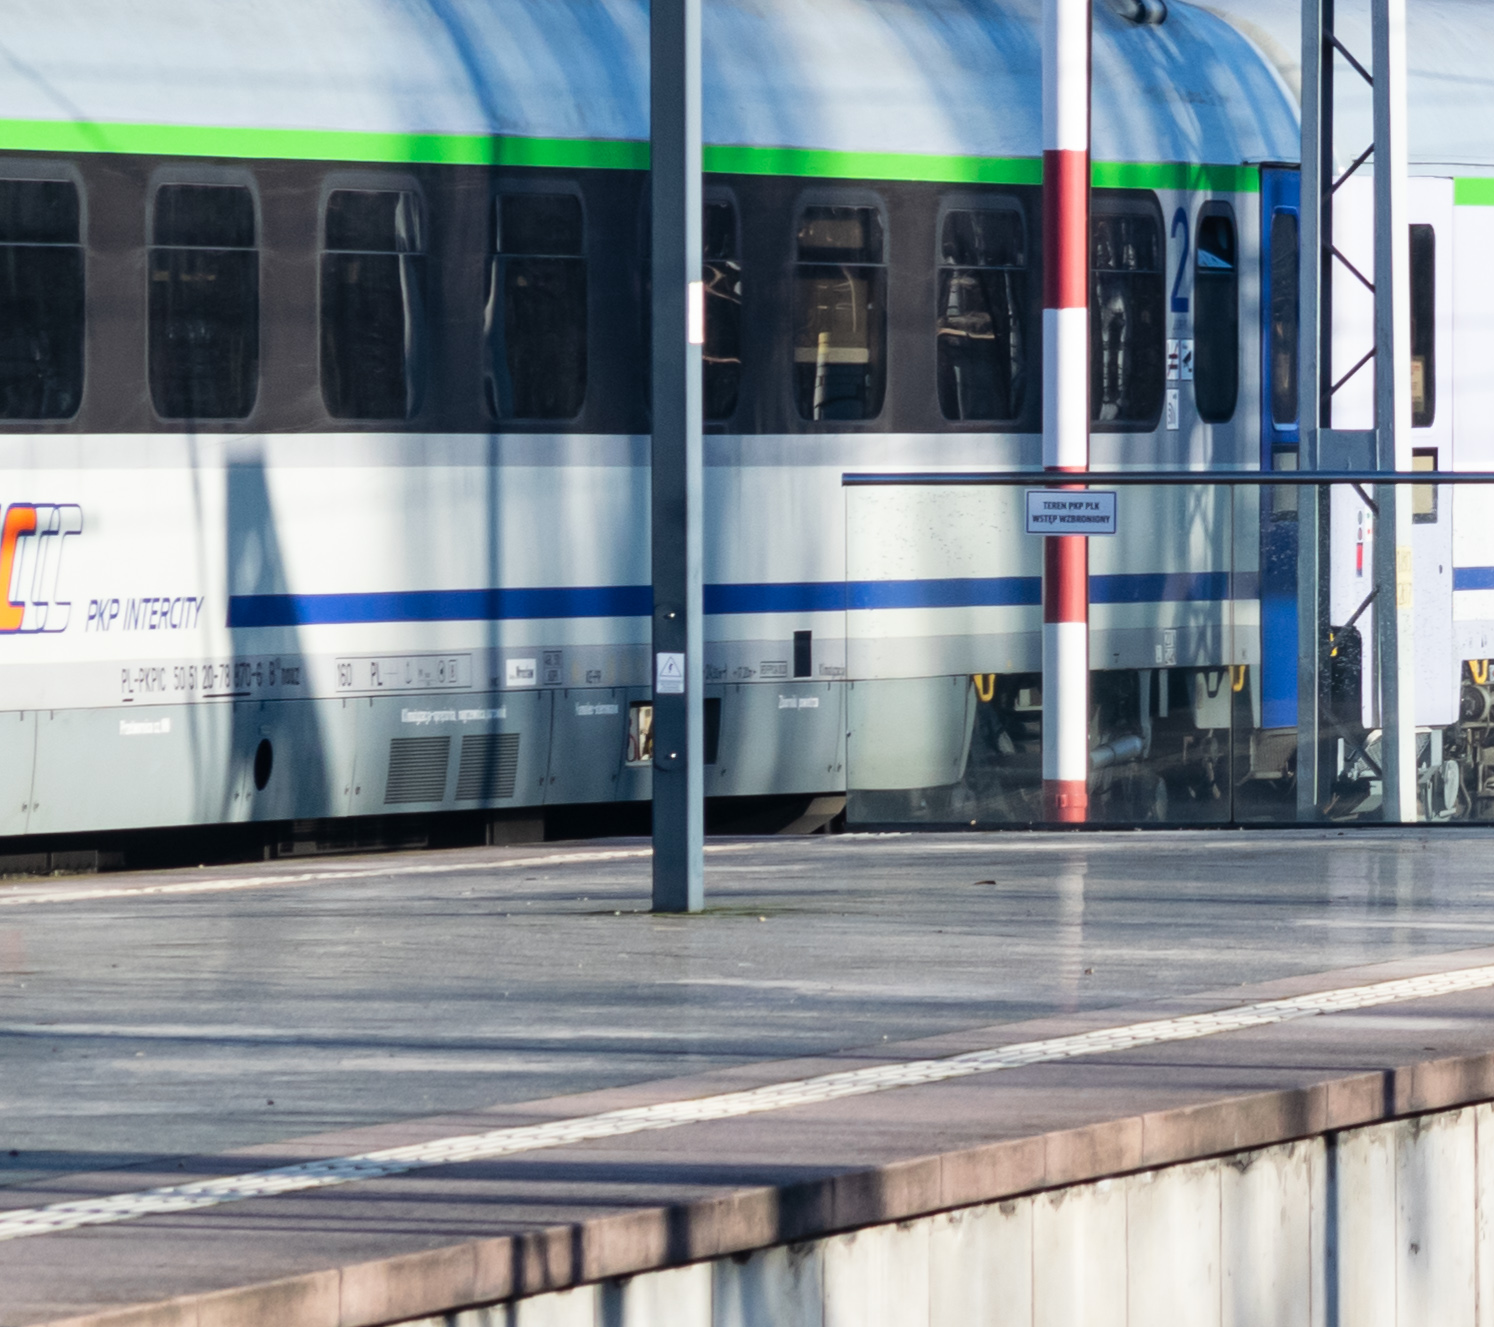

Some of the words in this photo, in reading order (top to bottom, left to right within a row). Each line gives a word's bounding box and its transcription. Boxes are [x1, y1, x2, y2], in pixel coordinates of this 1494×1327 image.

[1170, 206, 1189, 313] 2
[1043, 501, 1067, 510] TEREN
[1068, 501, 1084, 510] PKP
[1085, 501, 1100, 510] PLK
[1032, 514, 1058, 524] WSTĘP
[85, 598, 120, 632] PKP
[123, 596, 205, 631] INTERCITY
